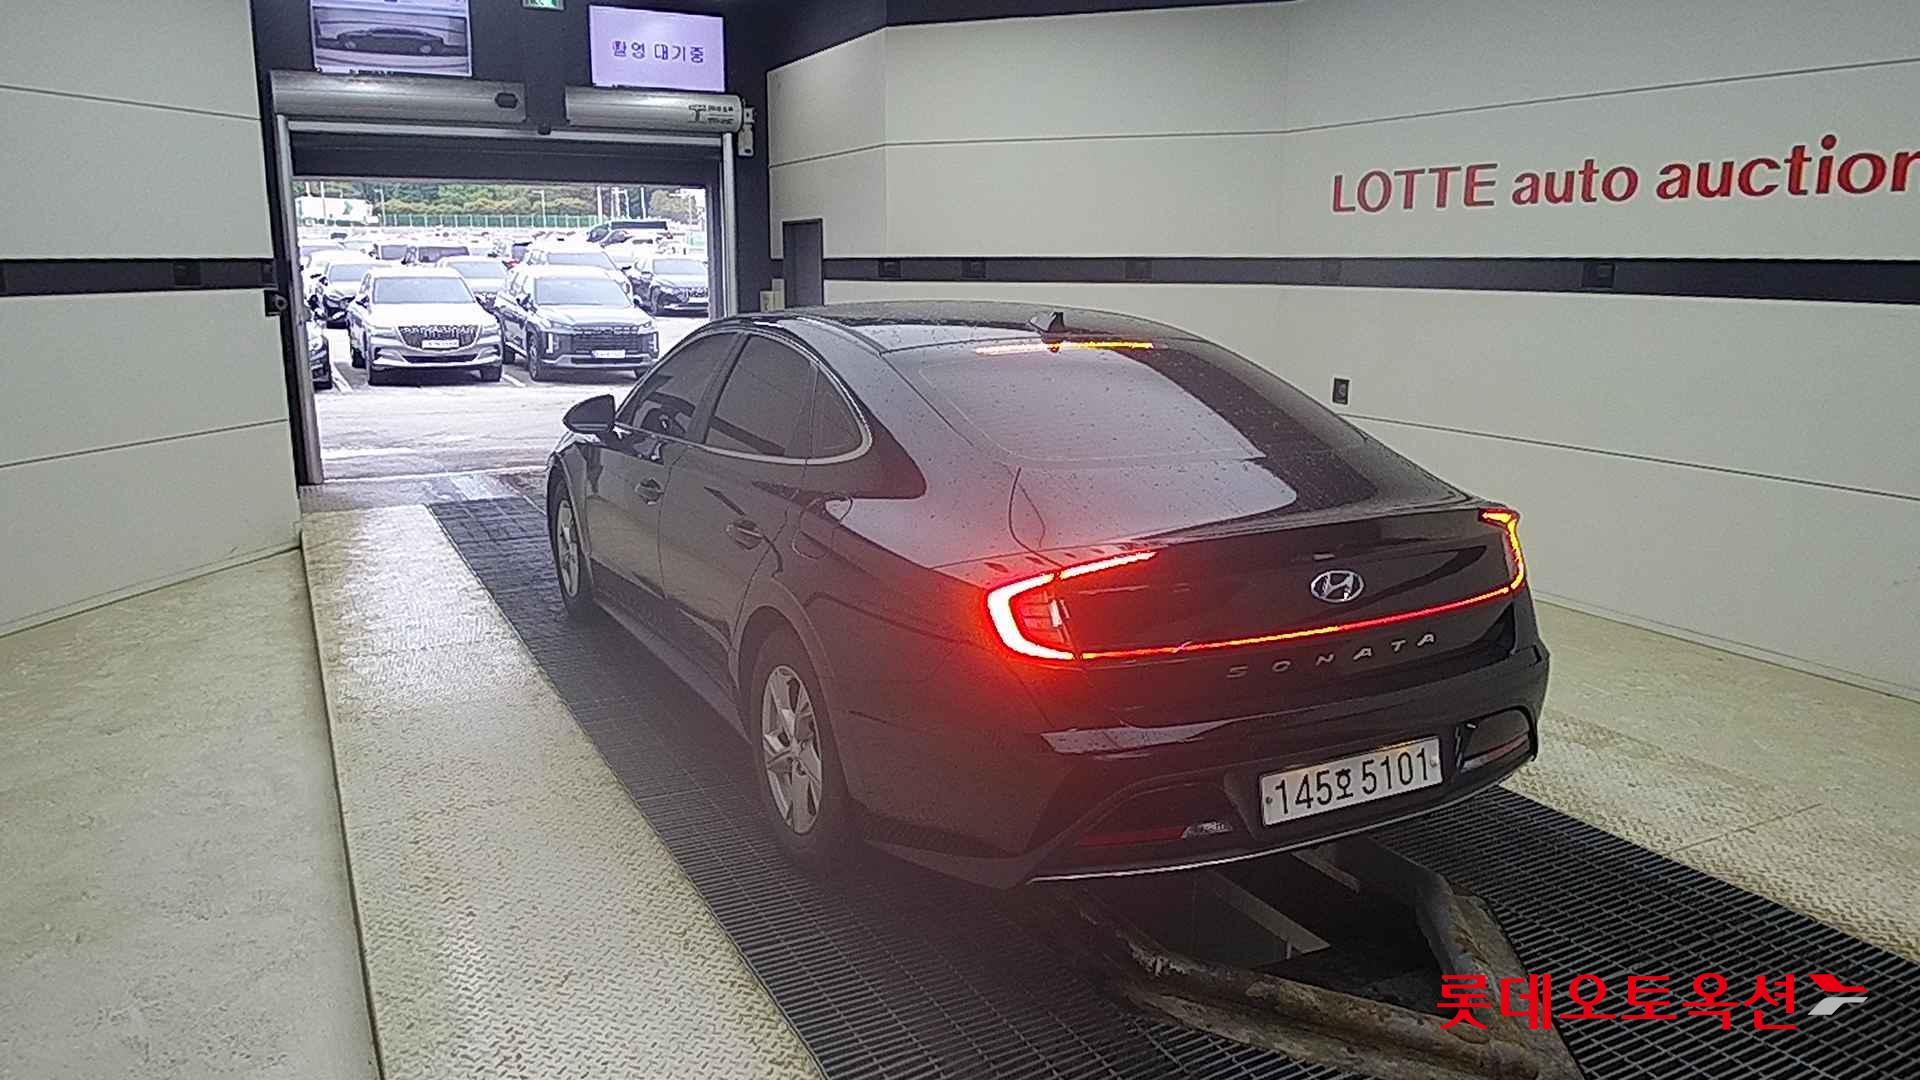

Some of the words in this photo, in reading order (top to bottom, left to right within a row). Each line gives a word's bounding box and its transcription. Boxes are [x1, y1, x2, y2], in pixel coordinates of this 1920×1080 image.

[654, 44, 704, 63] 대기중
[1332, 163, 1498, 212] LOTTE
[1512, 159, 1638, 205] auto
[1227, 634, 1435, 678] SONATA
[1275, 767, 1353, 814] 145호
[1362, 748, 1428, 795] 5101
